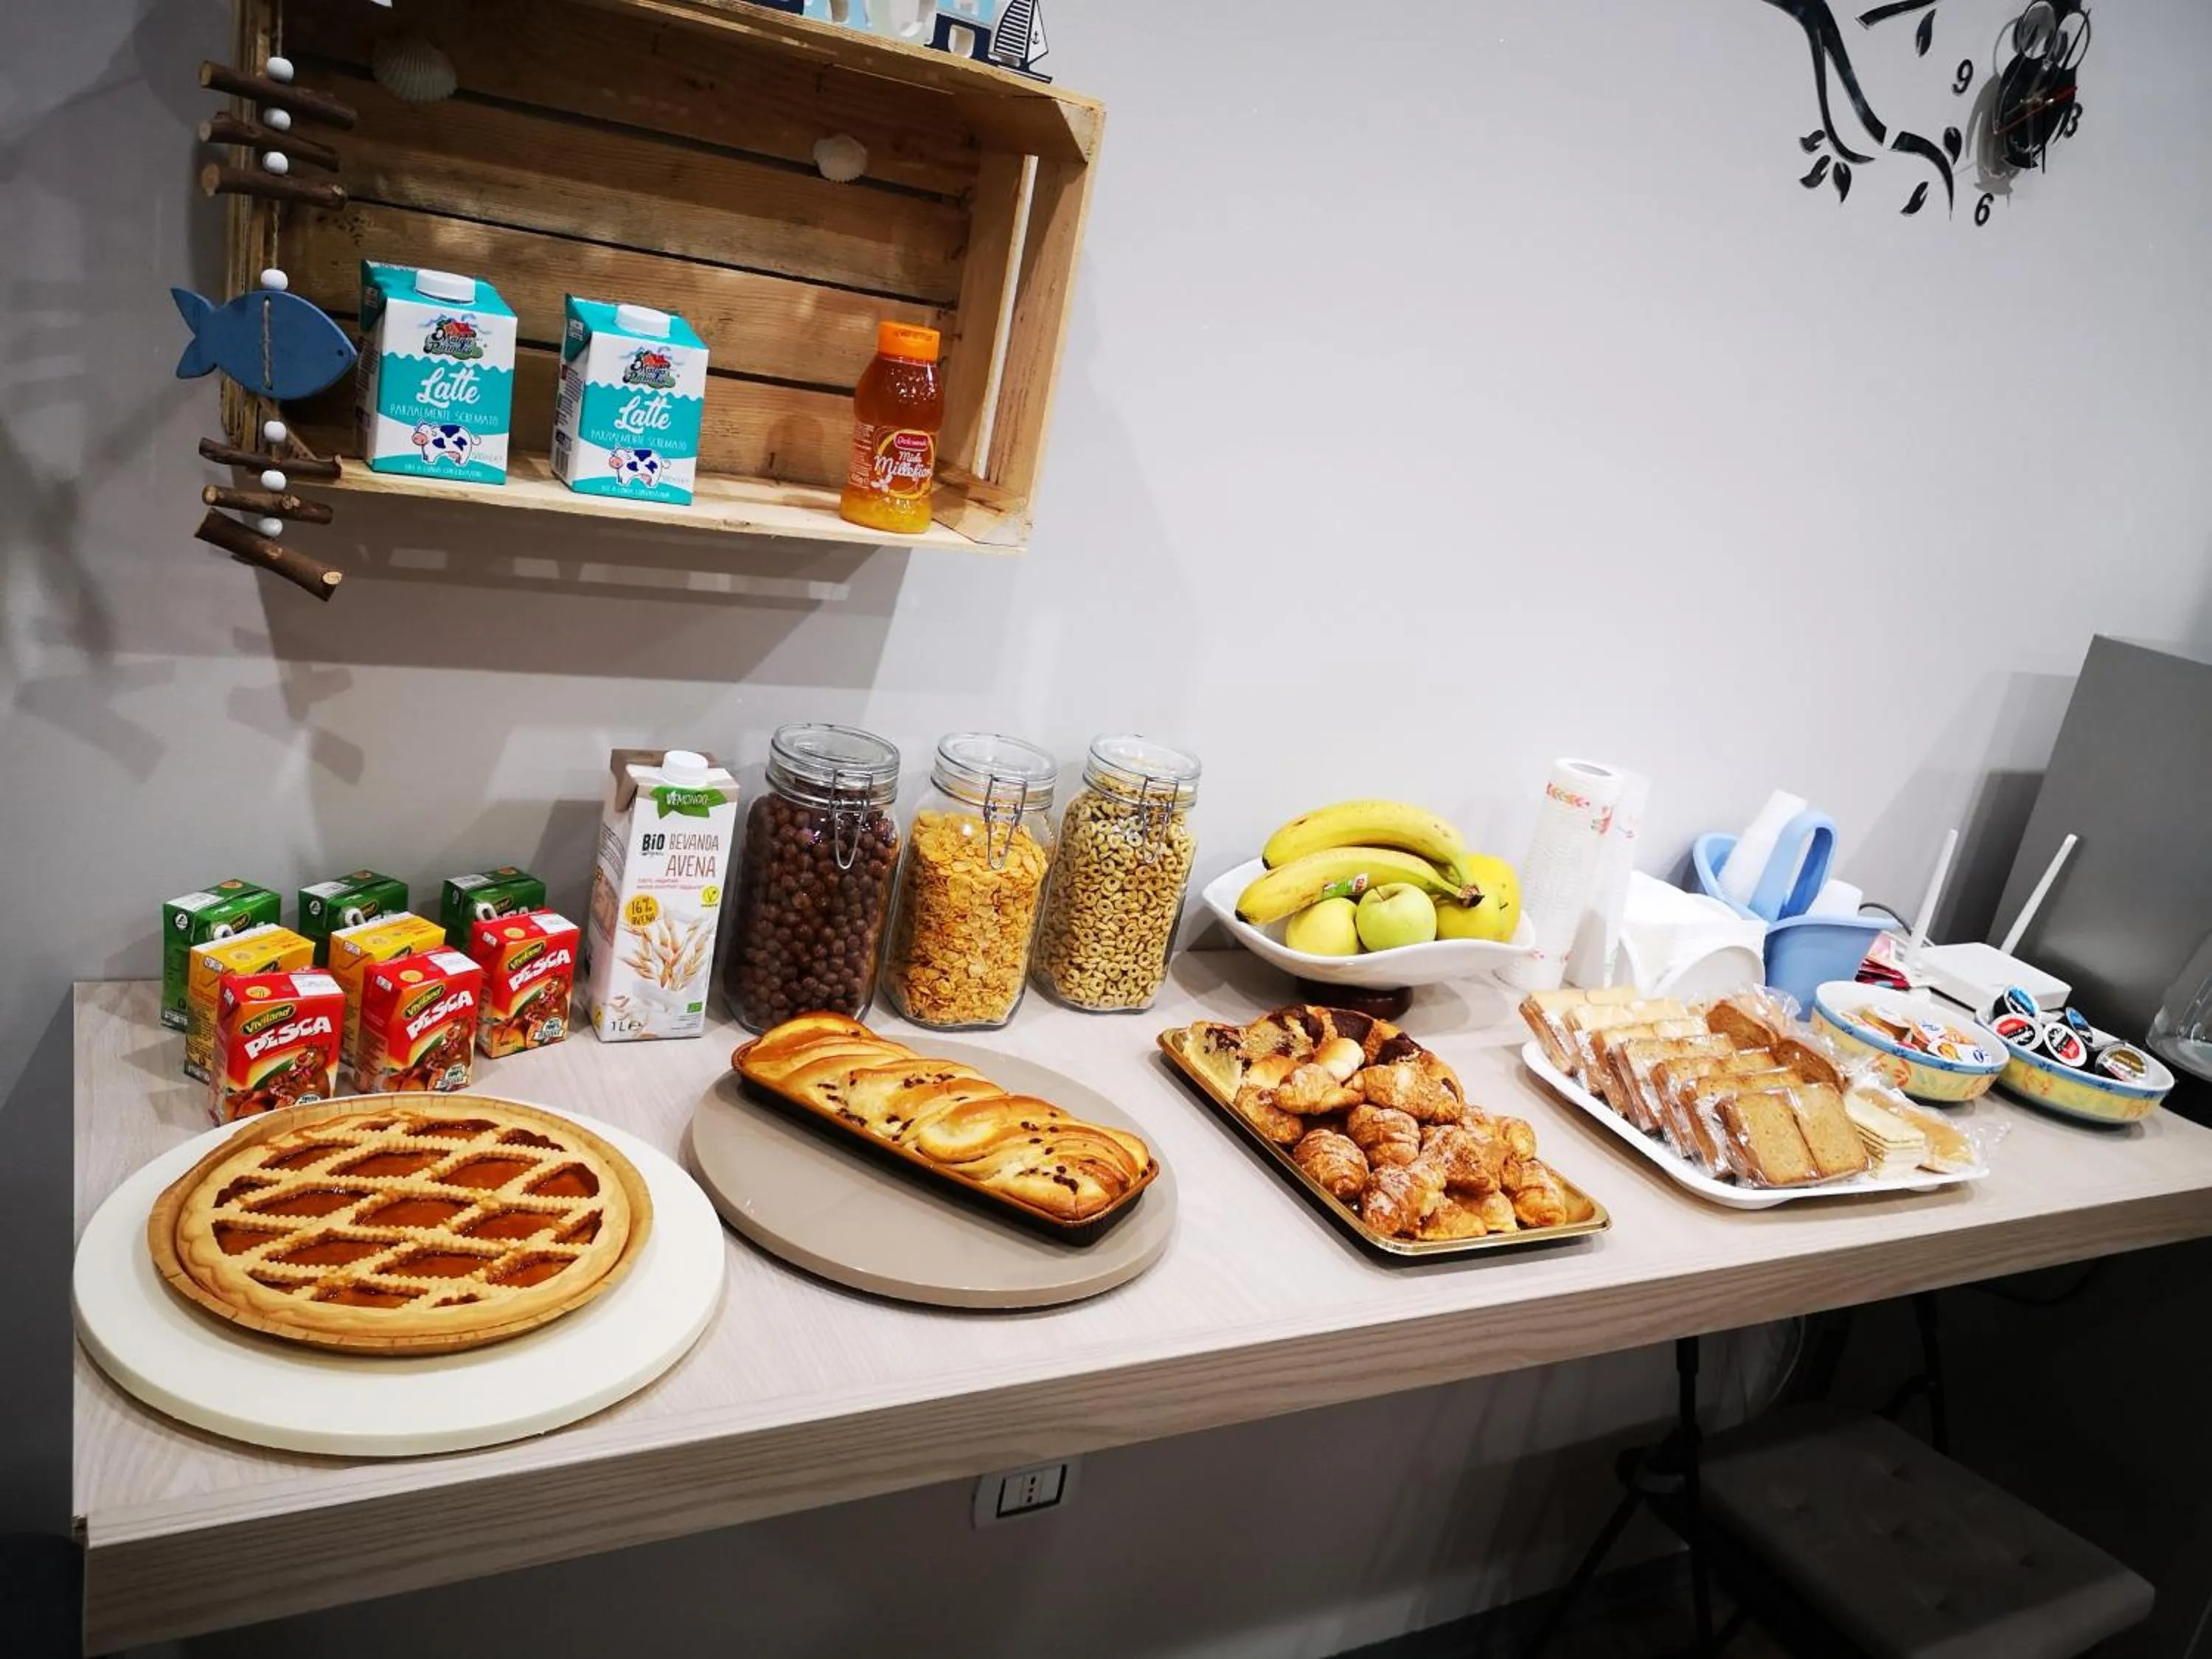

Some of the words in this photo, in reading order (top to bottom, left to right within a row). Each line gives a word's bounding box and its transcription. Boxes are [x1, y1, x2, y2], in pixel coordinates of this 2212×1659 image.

[1952, 58, 1974, 96] 9
[2063, 102, 2083, 139] 3
[1975, 192, 1994, 226] 6
[416, 367, 481, 408] Latte
[613, 395, 672, 434] Latte
[666, 791, 709, 806] VEMONDO
[669, 833, 719, 851] BEVANDA
[666, 855, 716, 877] AVENA
[508, 948, 571, 992] PESCA
[406, 990, 474, 1041] PESCA
[244, 1015, 332, 1060] PESCA
